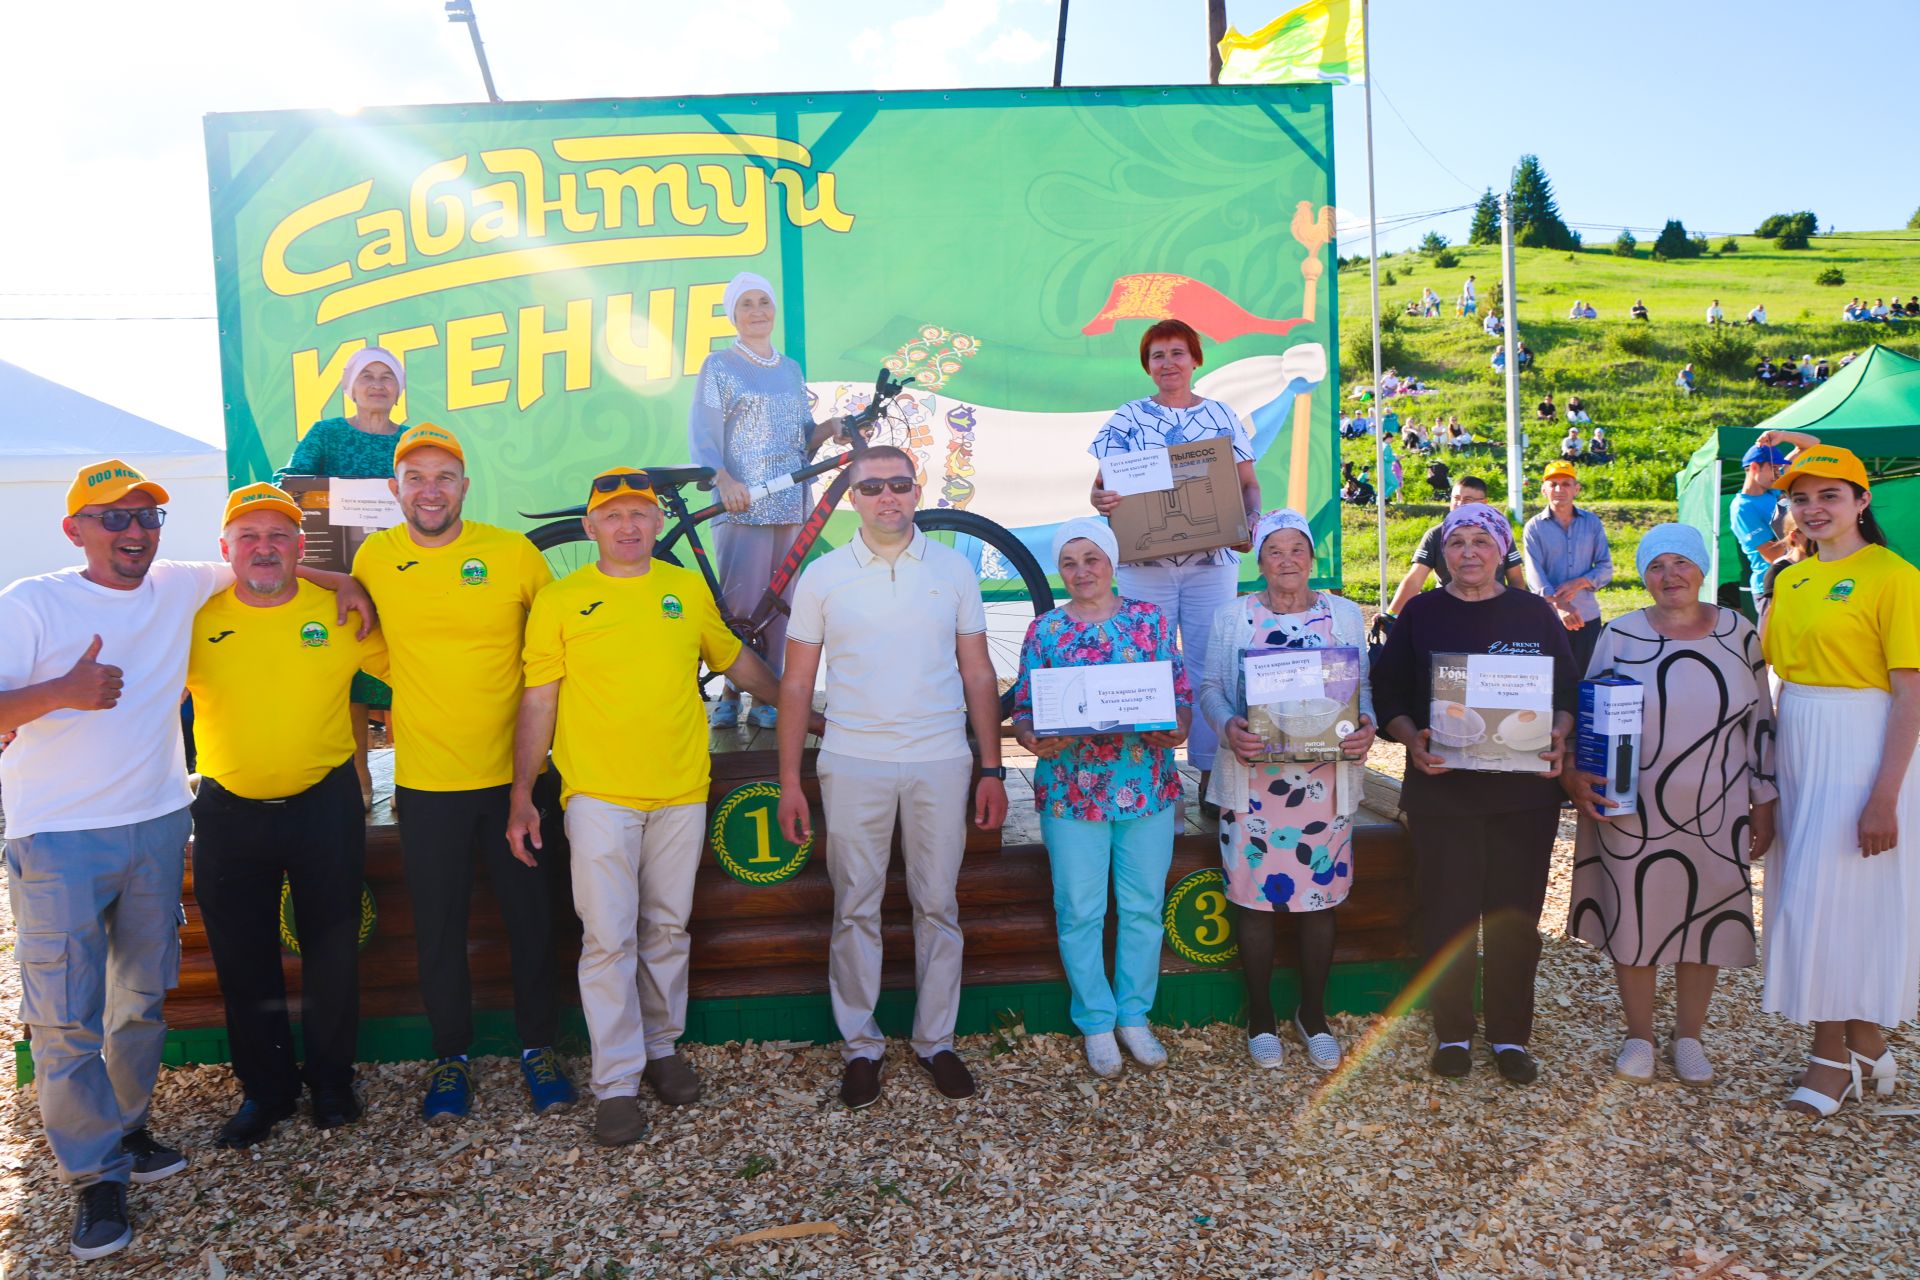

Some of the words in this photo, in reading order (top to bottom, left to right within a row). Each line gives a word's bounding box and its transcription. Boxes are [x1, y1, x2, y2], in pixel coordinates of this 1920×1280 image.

[1170, 448, 1216, 462] ПЫЛЕСОС
[88, 470, 112, 487] ООО
[1488, 640, 1543, 656] Elegance
[744, 806, 781, 863] 1
[1195, 890, 1231, 946] 3
